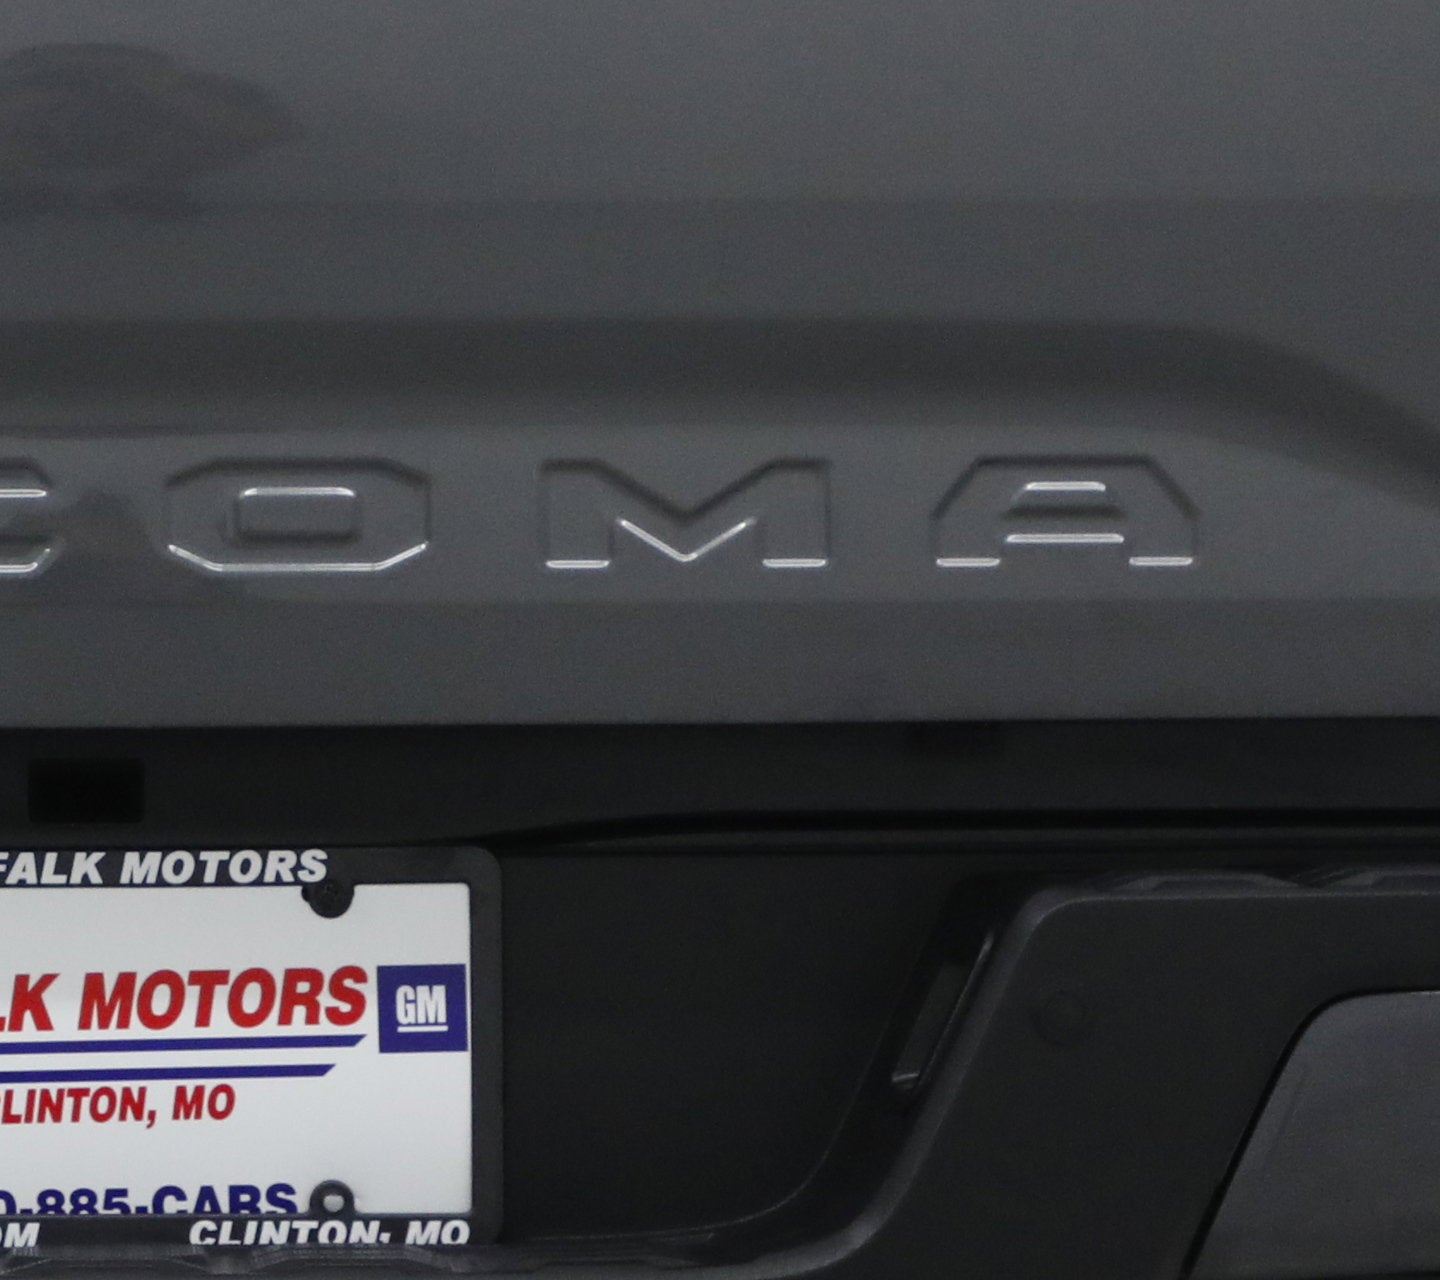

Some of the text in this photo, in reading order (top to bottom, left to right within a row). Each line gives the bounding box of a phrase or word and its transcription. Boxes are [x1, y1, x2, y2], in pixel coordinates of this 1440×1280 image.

[120, 849, 329, 885] MOTORS
[78, 965, 368, 1032] MOTORS
[395, 983, 448, 1026] GM
[171, 1083, 236, 1121] MO
[404, 1219, 471, 1245] MO
